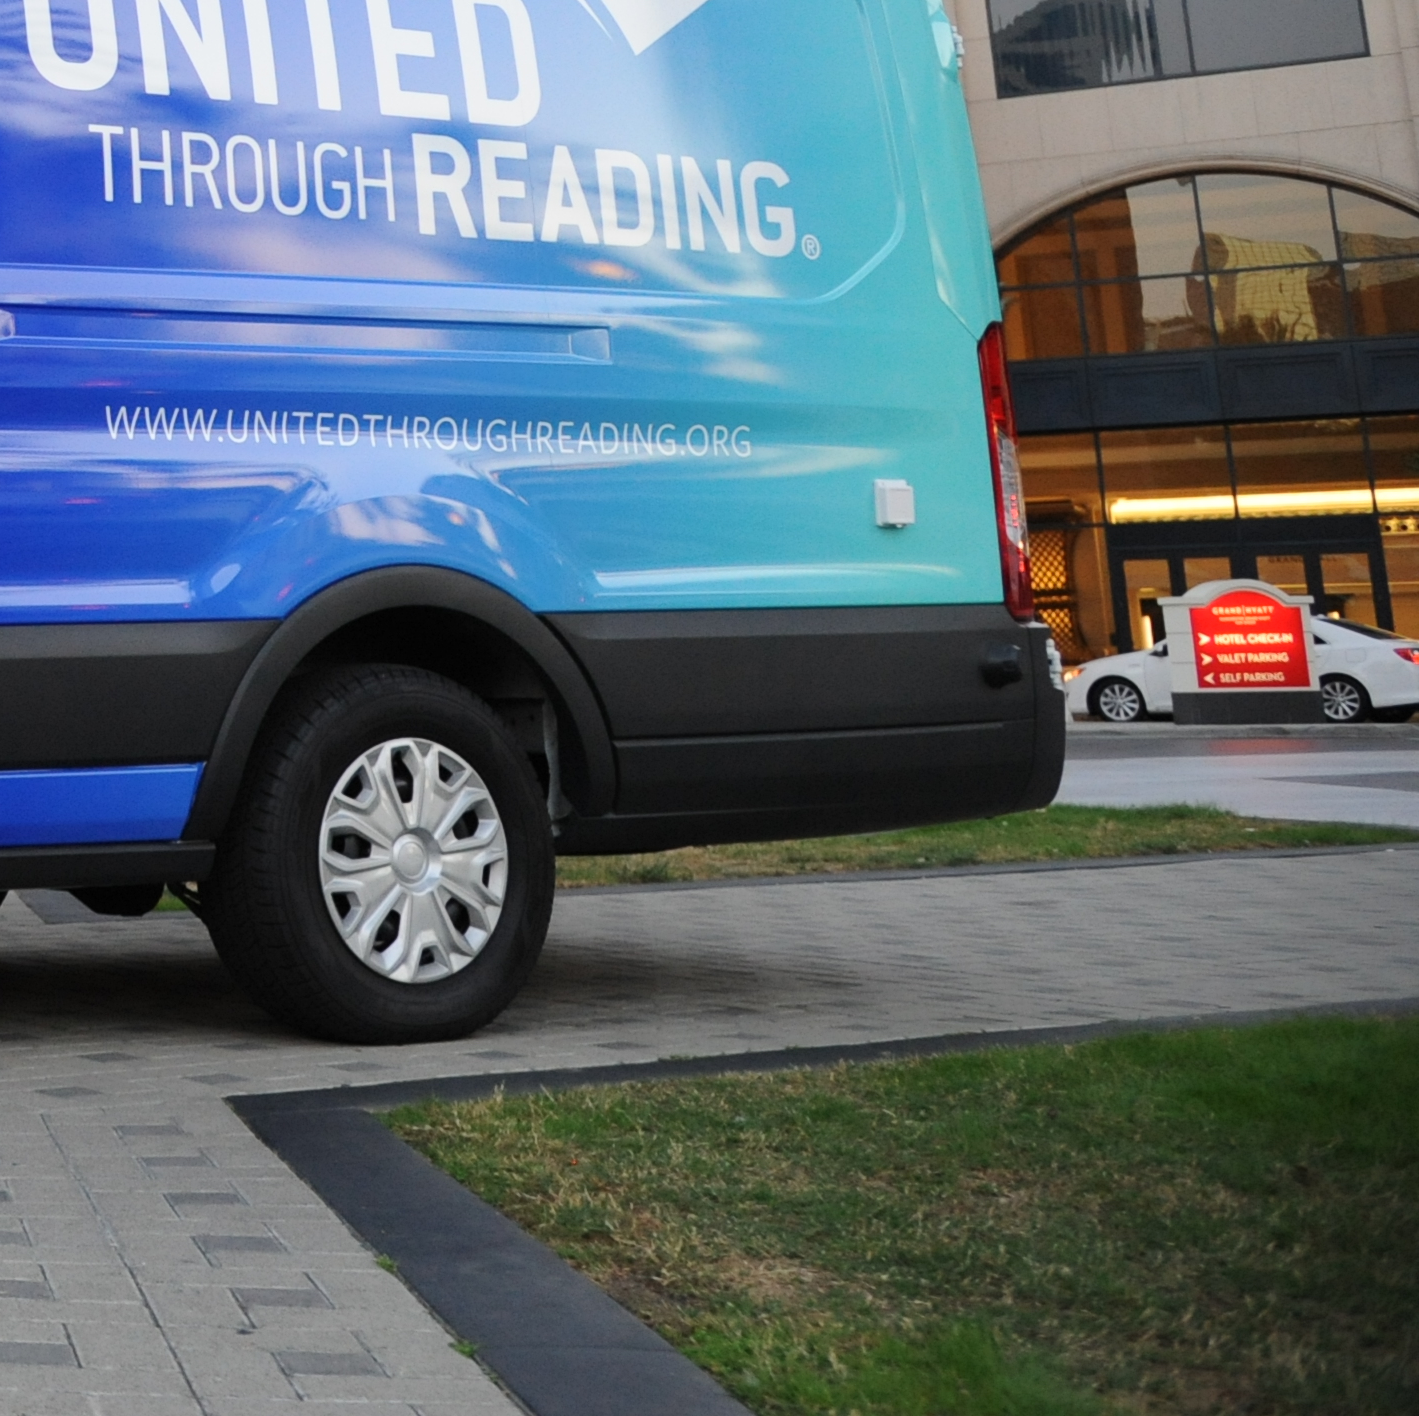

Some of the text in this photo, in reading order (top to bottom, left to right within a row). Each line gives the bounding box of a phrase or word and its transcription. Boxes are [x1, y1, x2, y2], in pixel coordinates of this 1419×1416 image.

[88, 123, 398, 223] THROUGH
[105, 404, 751, 458] WWW.UNITEDTHROUGHREADING.ORG
[1213, 632, 1294, 645] HOTEL CHECK-IN
[1216, 651, 1290, 664] VALET PARKING
[1219, 671, 1285, 683] SELF PARKING
